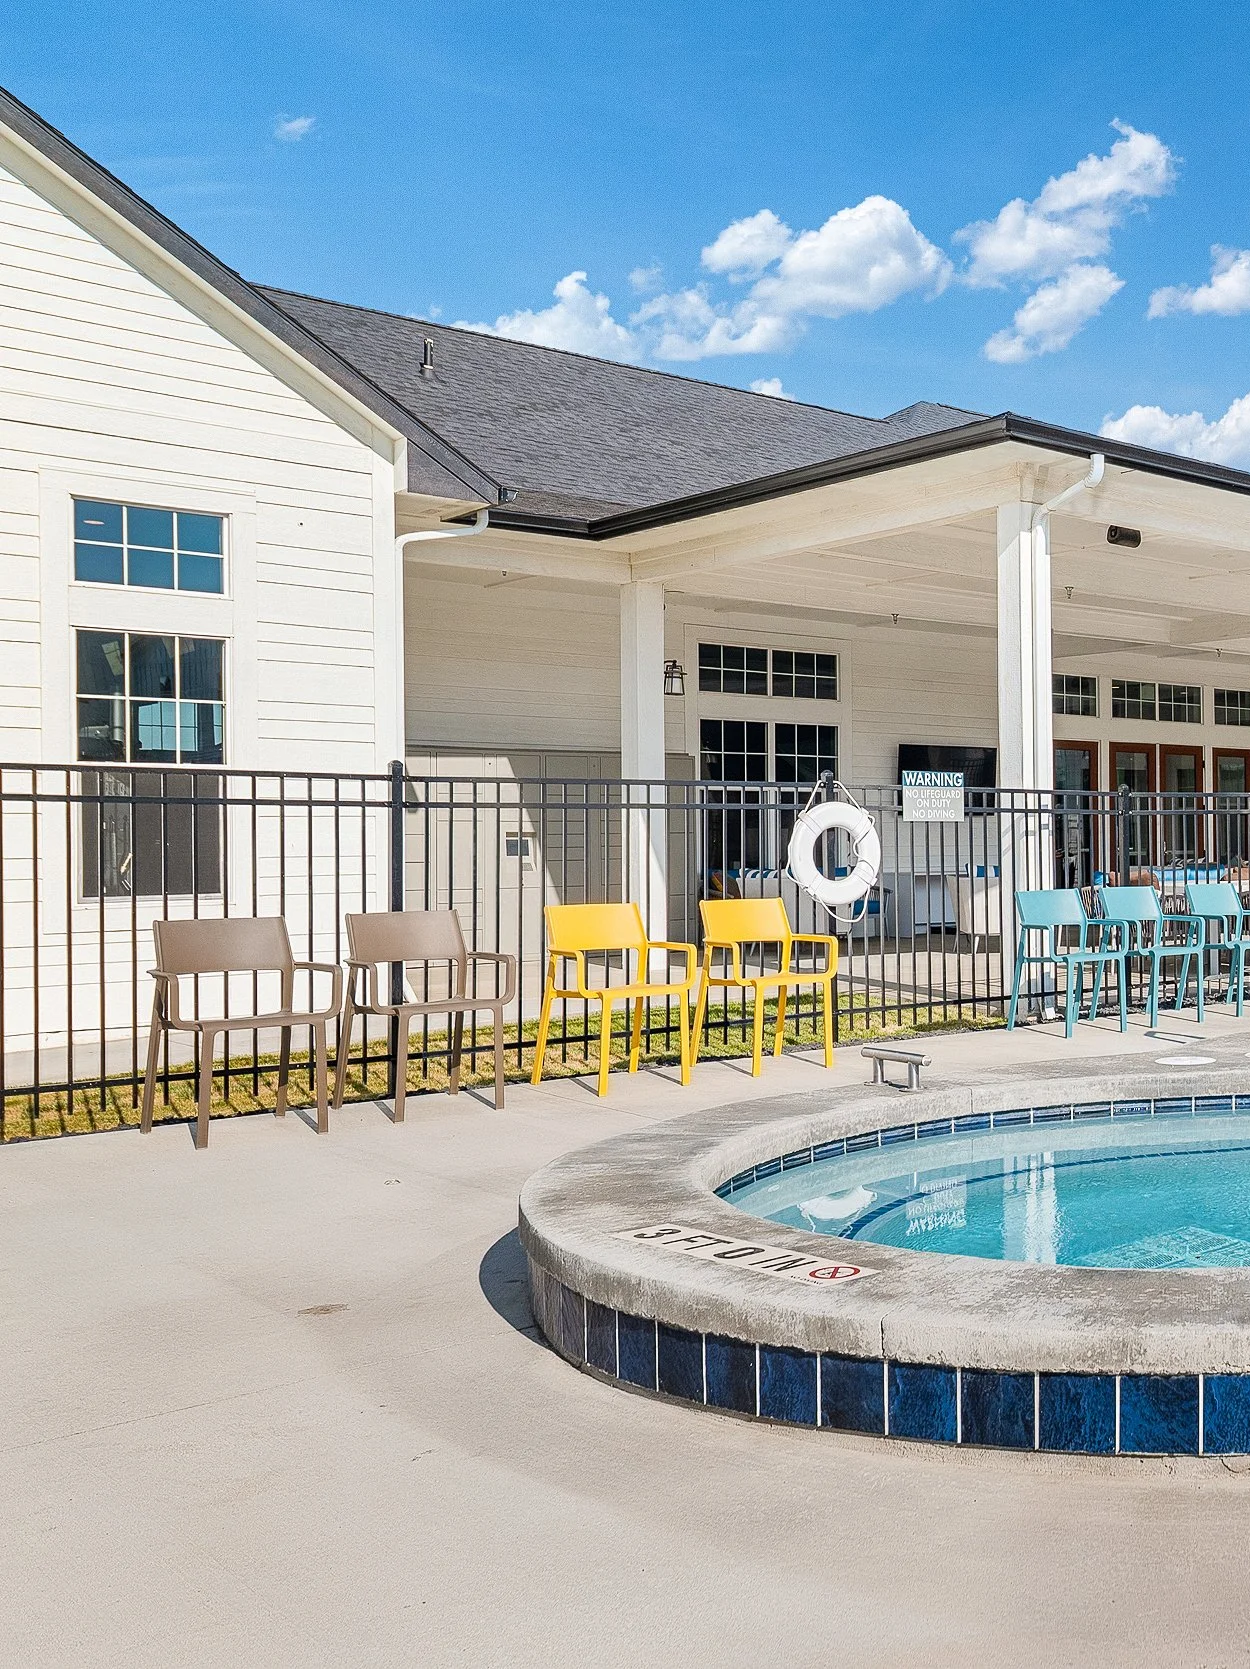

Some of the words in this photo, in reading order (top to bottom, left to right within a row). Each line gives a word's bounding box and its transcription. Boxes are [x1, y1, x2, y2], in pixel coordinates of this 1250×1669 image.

[904, 772, 963, 787] WARNING
[905, 789, 919, 798] NO
[921, 789, 961, 799] LIFEGUARD
[916, 799, 929, 808] ON
[931, 799, 951, 808] DUTY
[912, 809, 926, 818] NO
[927, 809, 955, 819] DIVING
[633, 1228, 682, 1239] 3
[661, 1234, 734, 1251] FT
[748, 1254, 818, 1272] IN
